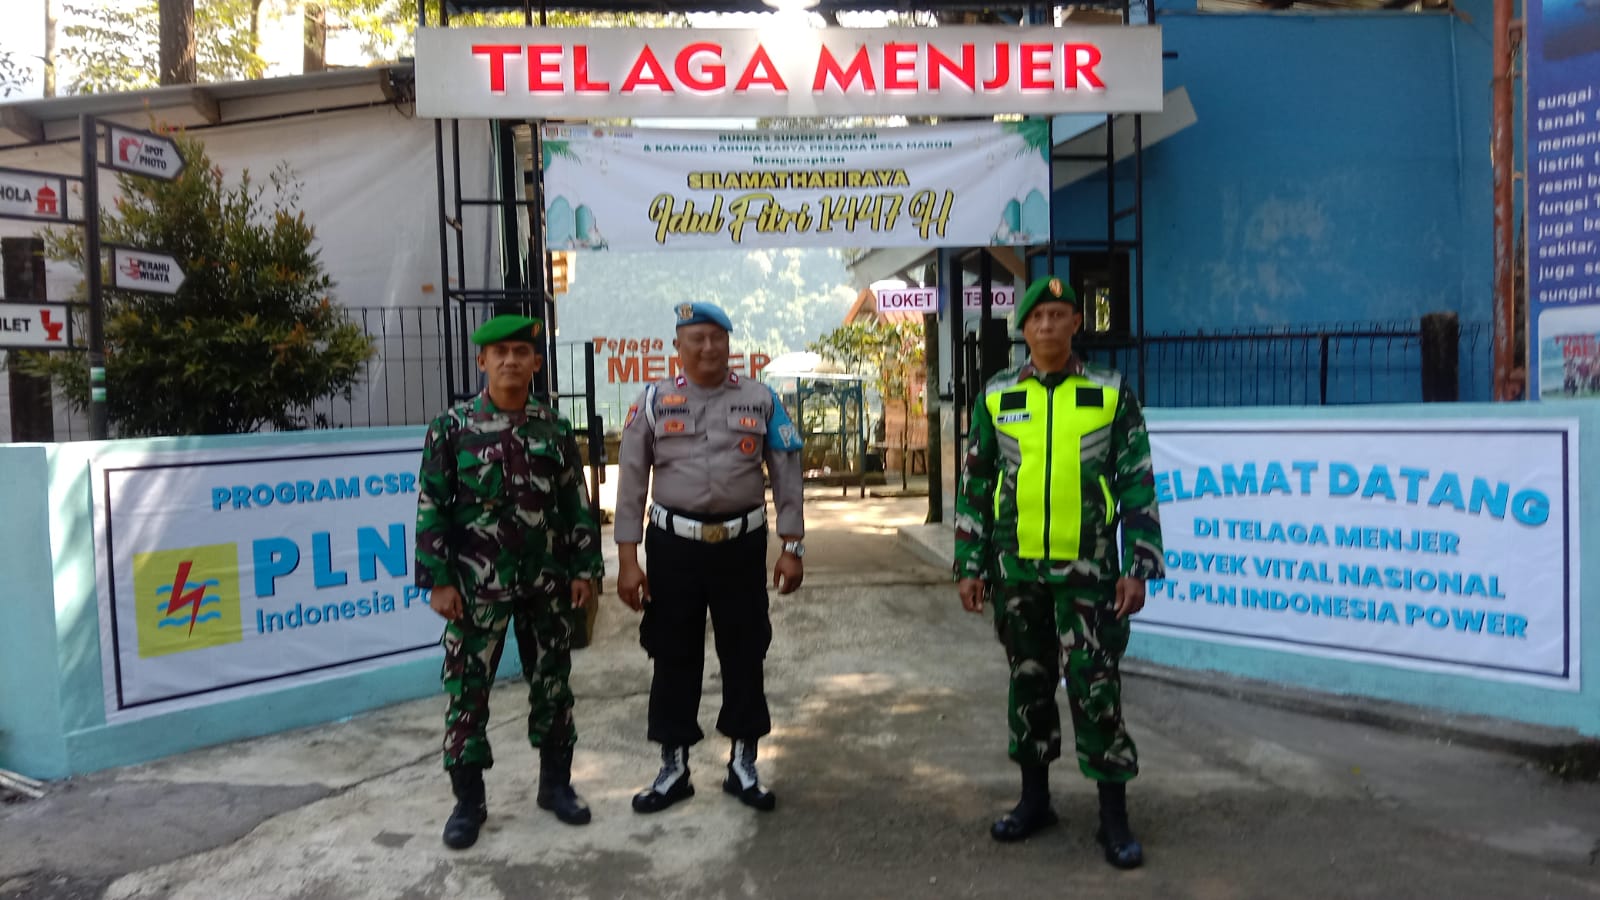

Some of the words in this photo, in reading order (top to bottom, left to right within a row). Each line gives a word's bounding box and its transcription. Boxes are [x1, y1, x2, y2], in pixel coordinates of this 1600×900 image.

[472, 41, 789, 93] TELAGA
[812, 41, 1106, 93] MENJER
[1538, 85, 1591, 111] sungai
[1538, 109, 1584, 132] tanah
[144, 144, 164, 158] SPOT
[139, 155, 167, 170] PHOTO
[1539, 153, 1584, 174] listrik
[688, 171, 787, 190] SELAMAT
[790, 169, 845, 189] HARI
[846, 169, 910, 188] RAYA
[1539, 174, 1582, 195] resmi
[649, 192, 725, 243] Idul
[729, 193, 813, 243] Fitri
[816, 194, 904, 232] 1447
[908, 190, 955, 240] H
[1538, 222, 1574, 241] juga
[137, 259, 170, 274] PERAHU
[139, 270, 170, 284] WISATA
[1538, 264, 1574, 284] juga
[882, 292, 933, 308] LOKET
[1540, 283, 1592, 304] sungai
[592, 336, 663, 355] Telaga
[211, 476, 360, 511] PROGRAM
[364, 472, 417, 495] CSR
[1328, 462, 1551, 527] DATANG
[1194, 516, 1220, 539] DI
[1227, 519, 1329, 546] TELAGA
[1335, 525, 1461, 556] MENJER
[252, 523, 408, 598] PLN
[1164, 549, 1247, 577] OBYEK
[1253, 557, 1333, 585] VITAL
[1338, 563, 1507, 599] NASIONAL
[256, 590, 396, 634] Indonesia
[1189, 581, 1237, 608] PLN
[1241, 586, 1402, 626] INDONESIA
[1405, 607, 1529, 639] POWER
